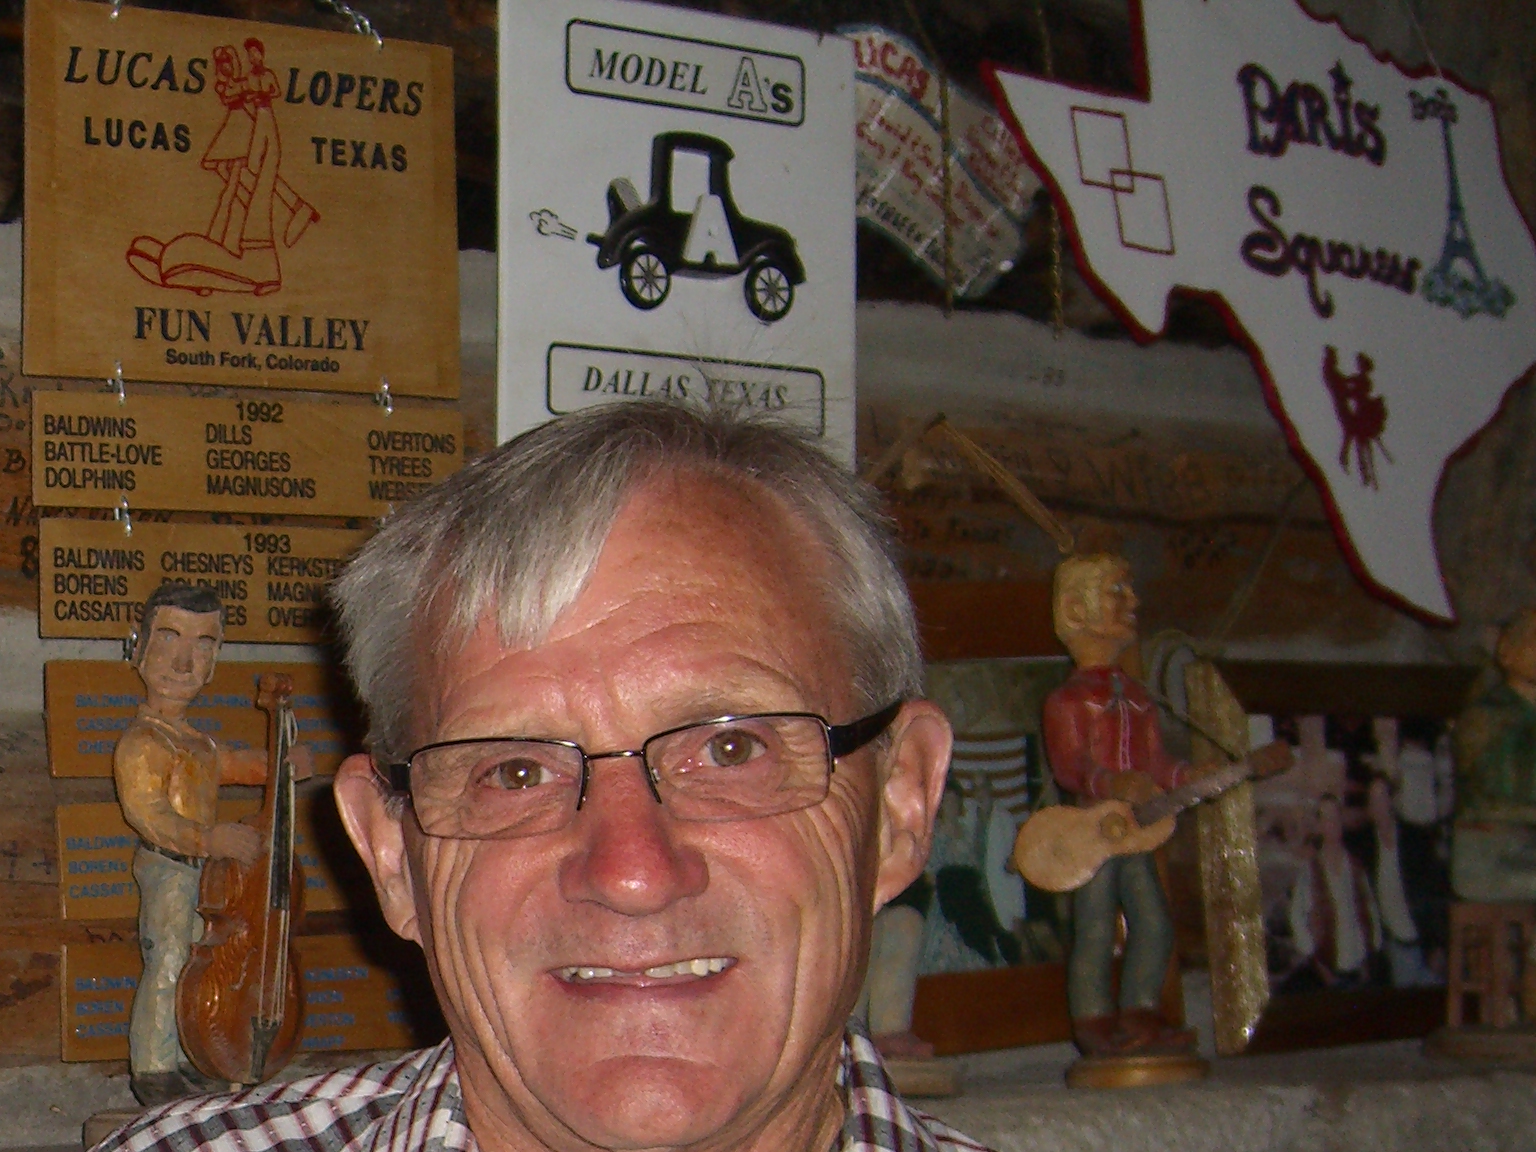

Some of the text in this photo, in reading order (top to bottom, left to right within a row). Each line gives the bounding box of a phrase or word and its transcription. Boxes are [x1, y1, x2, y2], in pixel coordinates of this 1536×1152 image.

[64, 46, 426, 118] LUCAS LOPERS
[589, 48, 708, 95] MODEL
[83, 116, 409, 173] LUCAS TEXAS
[133, 307, 371, 352] FUN VALLEY
[165, 348, 341, 374] South Fork, Colorado
[583, 366, 690, 400] DALLAS
[235, 402, 284, 424] 1992
[43, 415, 137, 440] BALDWINS
[205, 424, 253, 446] DILLS
[44, 441, 163, 467] BATTLE-LOVE
[367, 429, 457, 455] OVERTONS
[206, 449, 292, 473] GEORGES
[368, 455, 433, 479] TYREES
[44, 467, 137, 492] DOLPHINS
[206, 476, 317, 500] MAGNUSONS
[243, 533, 292, 554] 1993
[54, 547, 145, 572] BALDWINS
[161, 551, 254, 576] CHESNEYS
[54, 574, 128, 597] BORENS
[54, 600, 145, 624] CASSATTS
[75, 694, 147, 707] BALDWIN
[69, 881, 136, 899] CASSATT
[75, 976, 138, 991] BALDWIN
[75, 1022, 130, 1038] CASSAT
